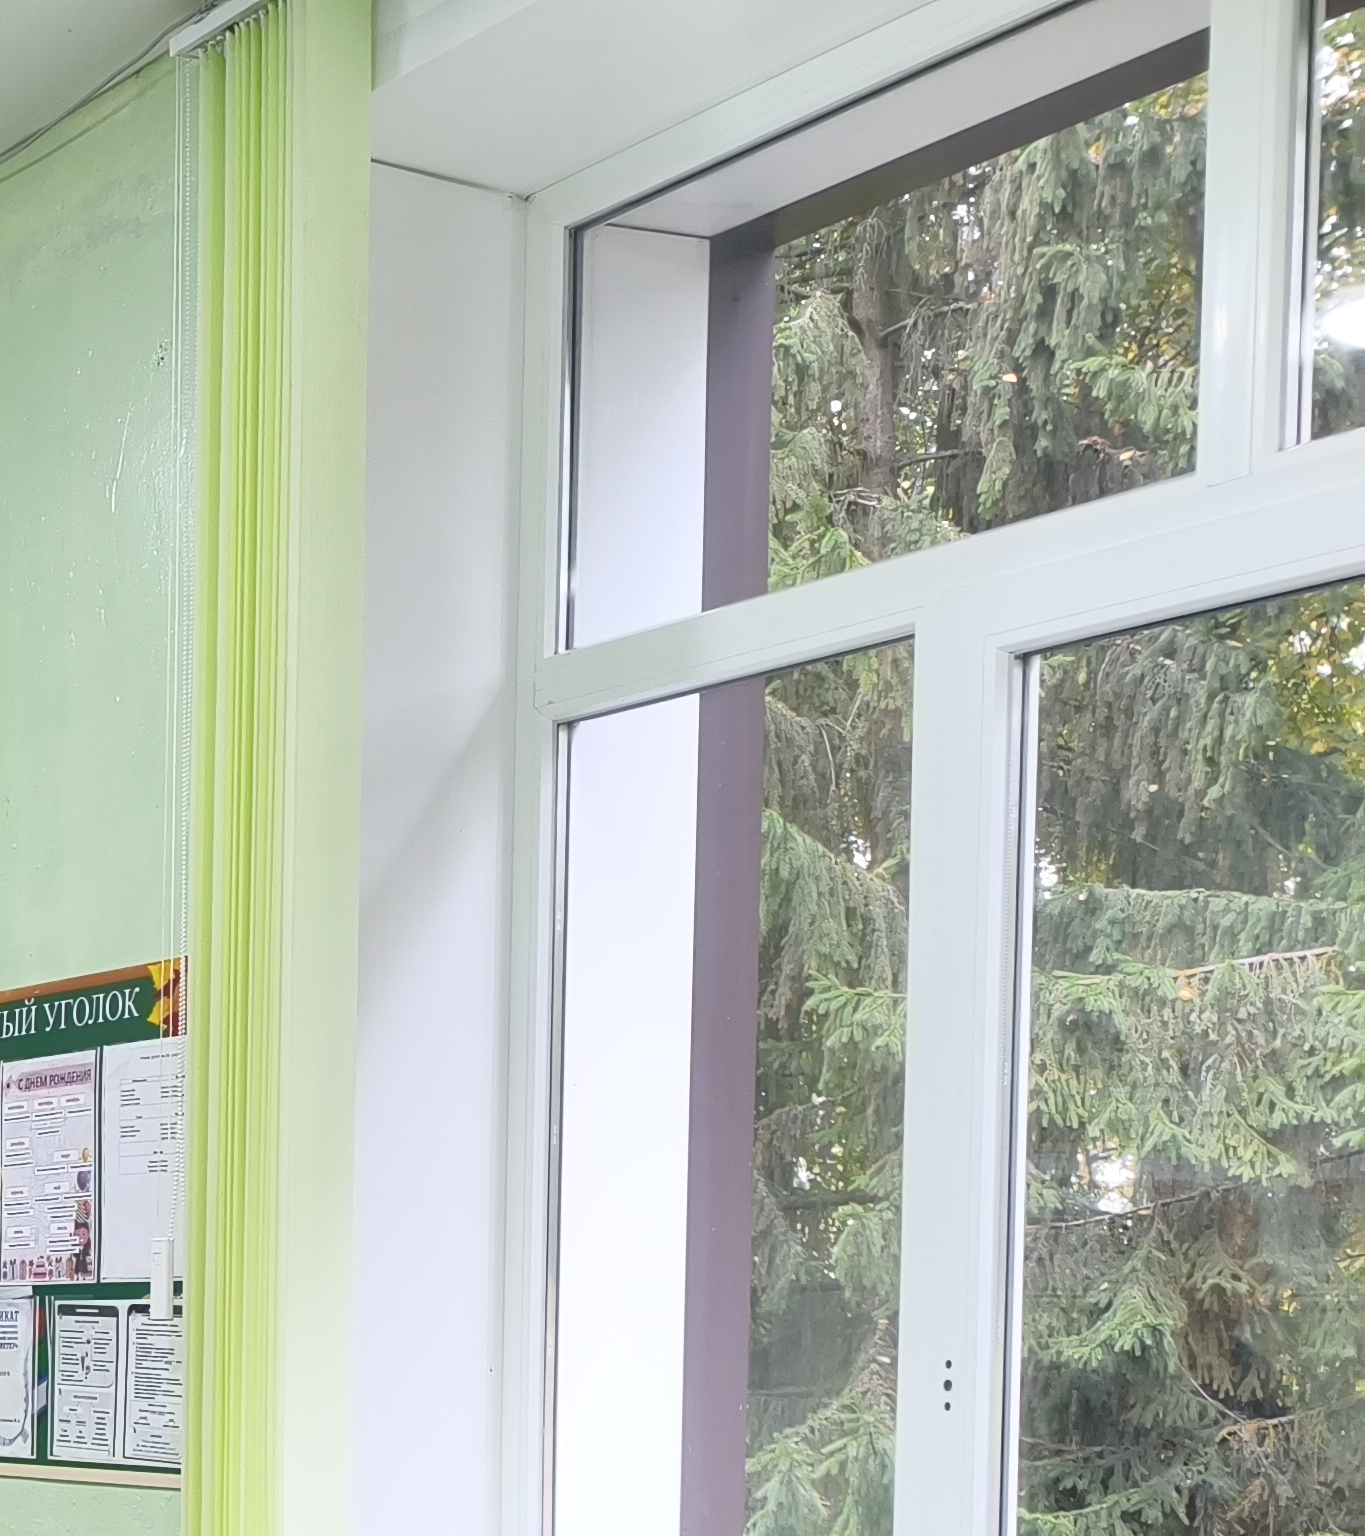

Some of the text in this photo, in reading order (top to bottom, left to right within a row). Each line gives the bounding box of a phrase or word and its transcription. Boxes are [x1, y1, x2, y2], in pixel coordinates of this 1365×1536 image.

[44, 985, 141, 1034] УГОЛОК
[18, 1068, 92, 1091] С ДНЕМ РОЖДЕНИЯ
